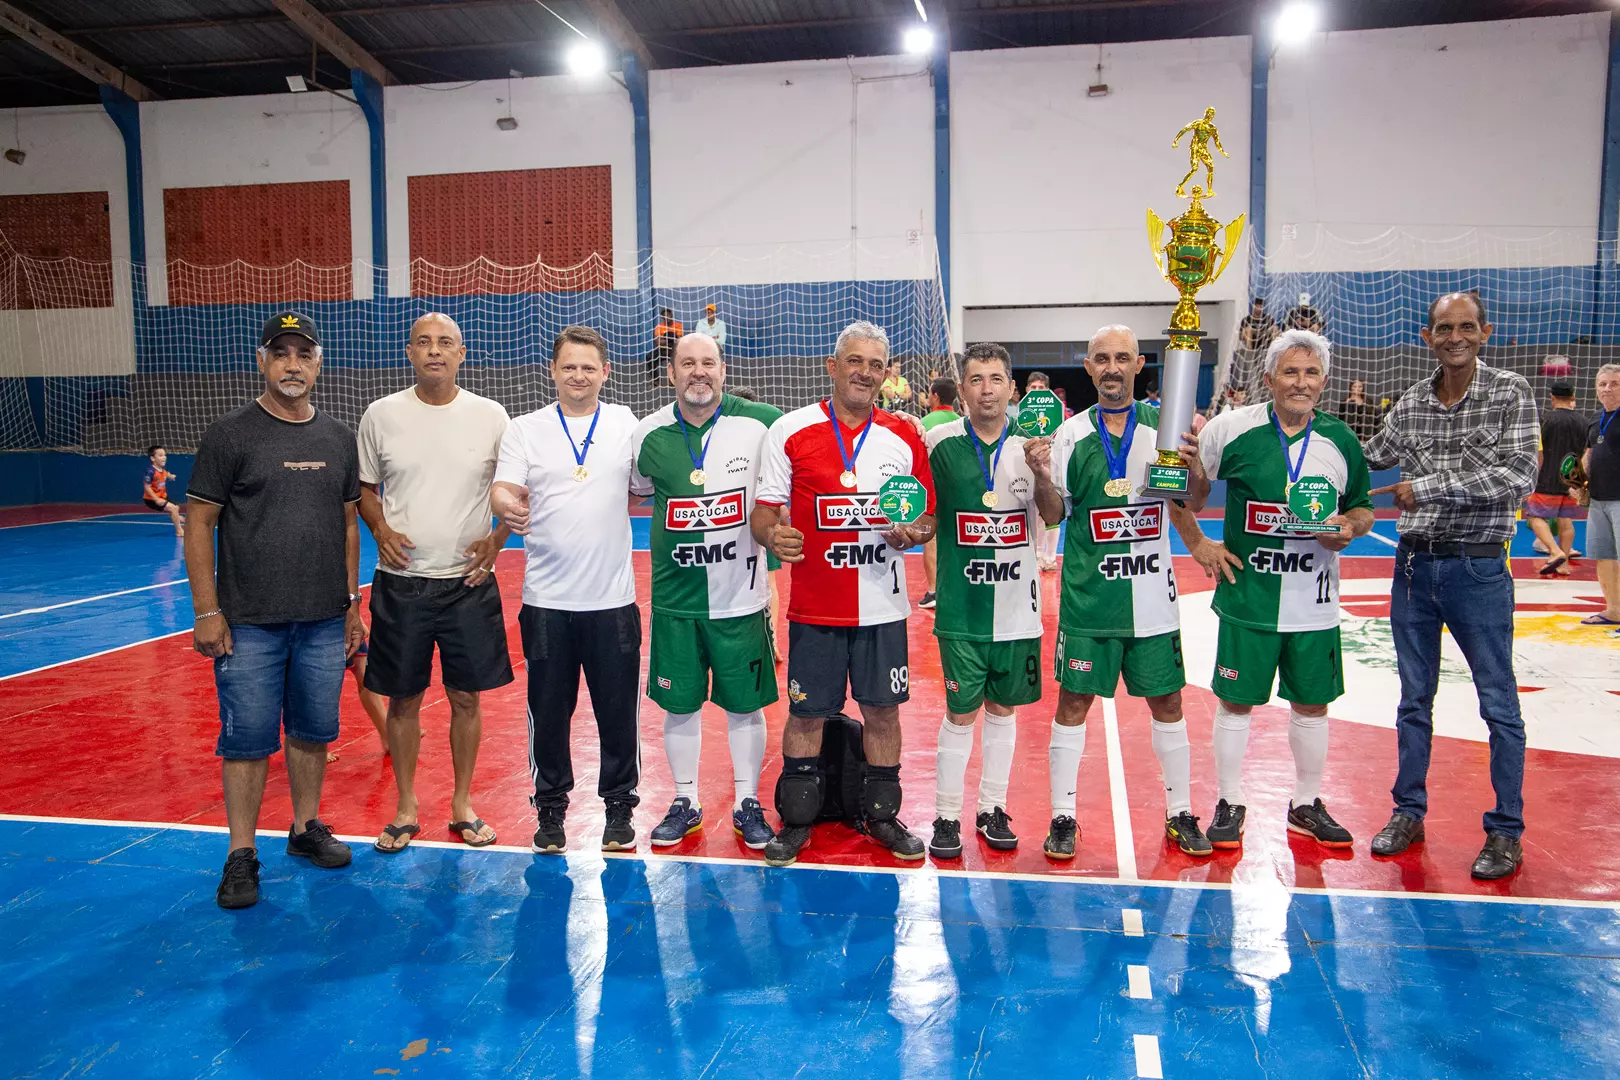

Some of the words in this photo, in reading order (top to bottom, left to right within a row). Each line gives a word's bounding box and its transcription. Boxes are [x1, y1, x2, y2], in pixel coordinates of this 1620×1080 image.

[725, 457, 750, 468] UNIDADE
[879, 463, 900, 473] UNIDADE
[898, 482, 918, 490] COPA
[1309, 482, 1329, 490] COPA
[828, 508, 883, 517] USACUCA
[672, 540, 737, 566] FMC
[827, 543, 887, 566] FMC
[1100, 553, 1160, 578] FMC
[1250, 549, 1315, 573] FMC
[746, 555, 758, 591] 7
[890, 559, 900, 595] 1
[966, 560, 1021, 582] FMC
[1030, 579, 1037, 613] 9
[1167, 567, 1176, 603] 5
[1316, 569, 1331, 604] 11
[1171, 635, 1182, 669] 5
[749, 658, 762, 692] 7
[889, 665, 909, 694] 89
[1025, 655, 1038, 687] 9
